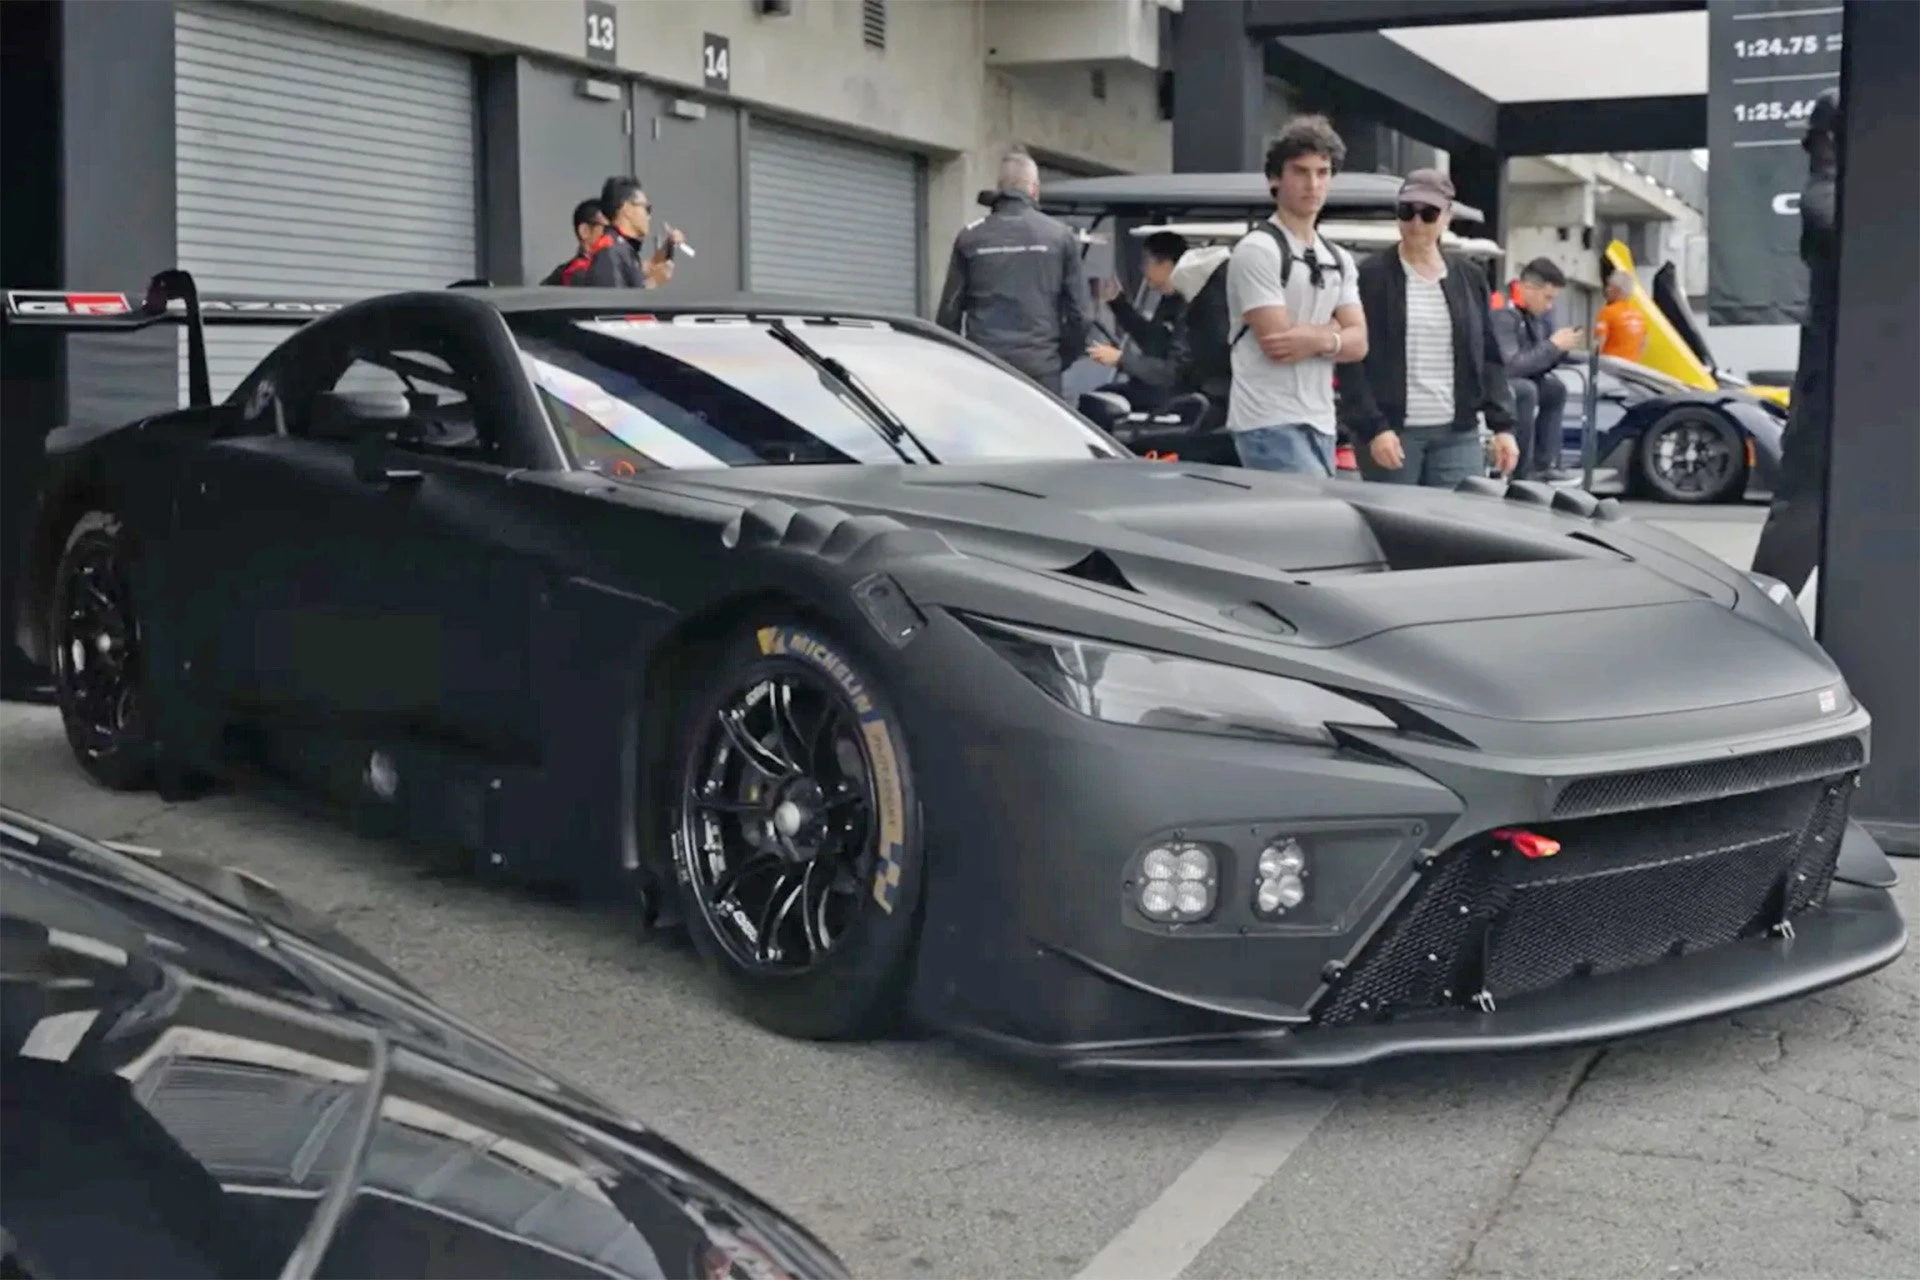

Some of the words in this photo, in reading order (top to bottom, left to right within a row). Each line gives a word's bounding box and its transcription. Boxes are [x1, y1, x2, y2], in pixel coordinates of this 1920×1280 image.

[588, 14, 615, 51] 13
[1734, 35, 1818, 58] 1:24.75
[704, 45, 729, 81] 14
[790, 634, 872, 713] MICHELIN
